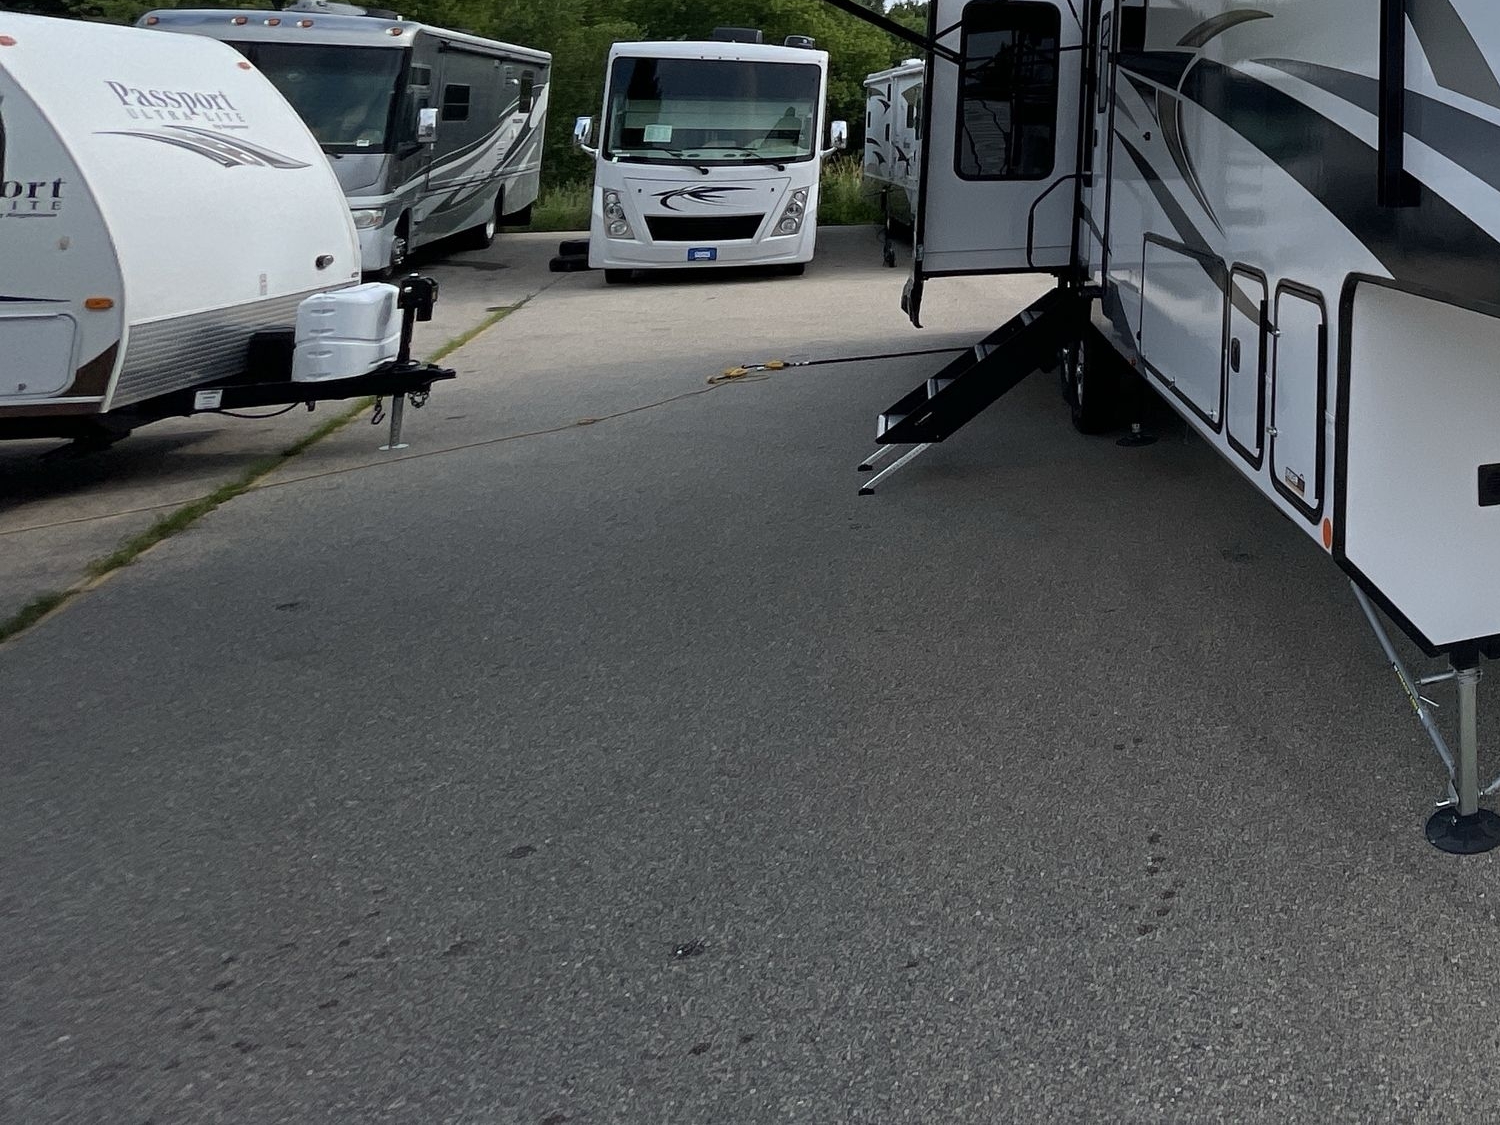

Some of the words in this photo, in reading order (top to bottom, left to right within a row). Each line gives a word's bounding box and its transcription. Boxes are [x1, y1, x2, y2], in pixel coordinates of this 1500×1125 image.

[104, 80, 237, 115] Passport
[126, 108, 193, 121] ULTRA
[203, 112, 245, 123] LITE
